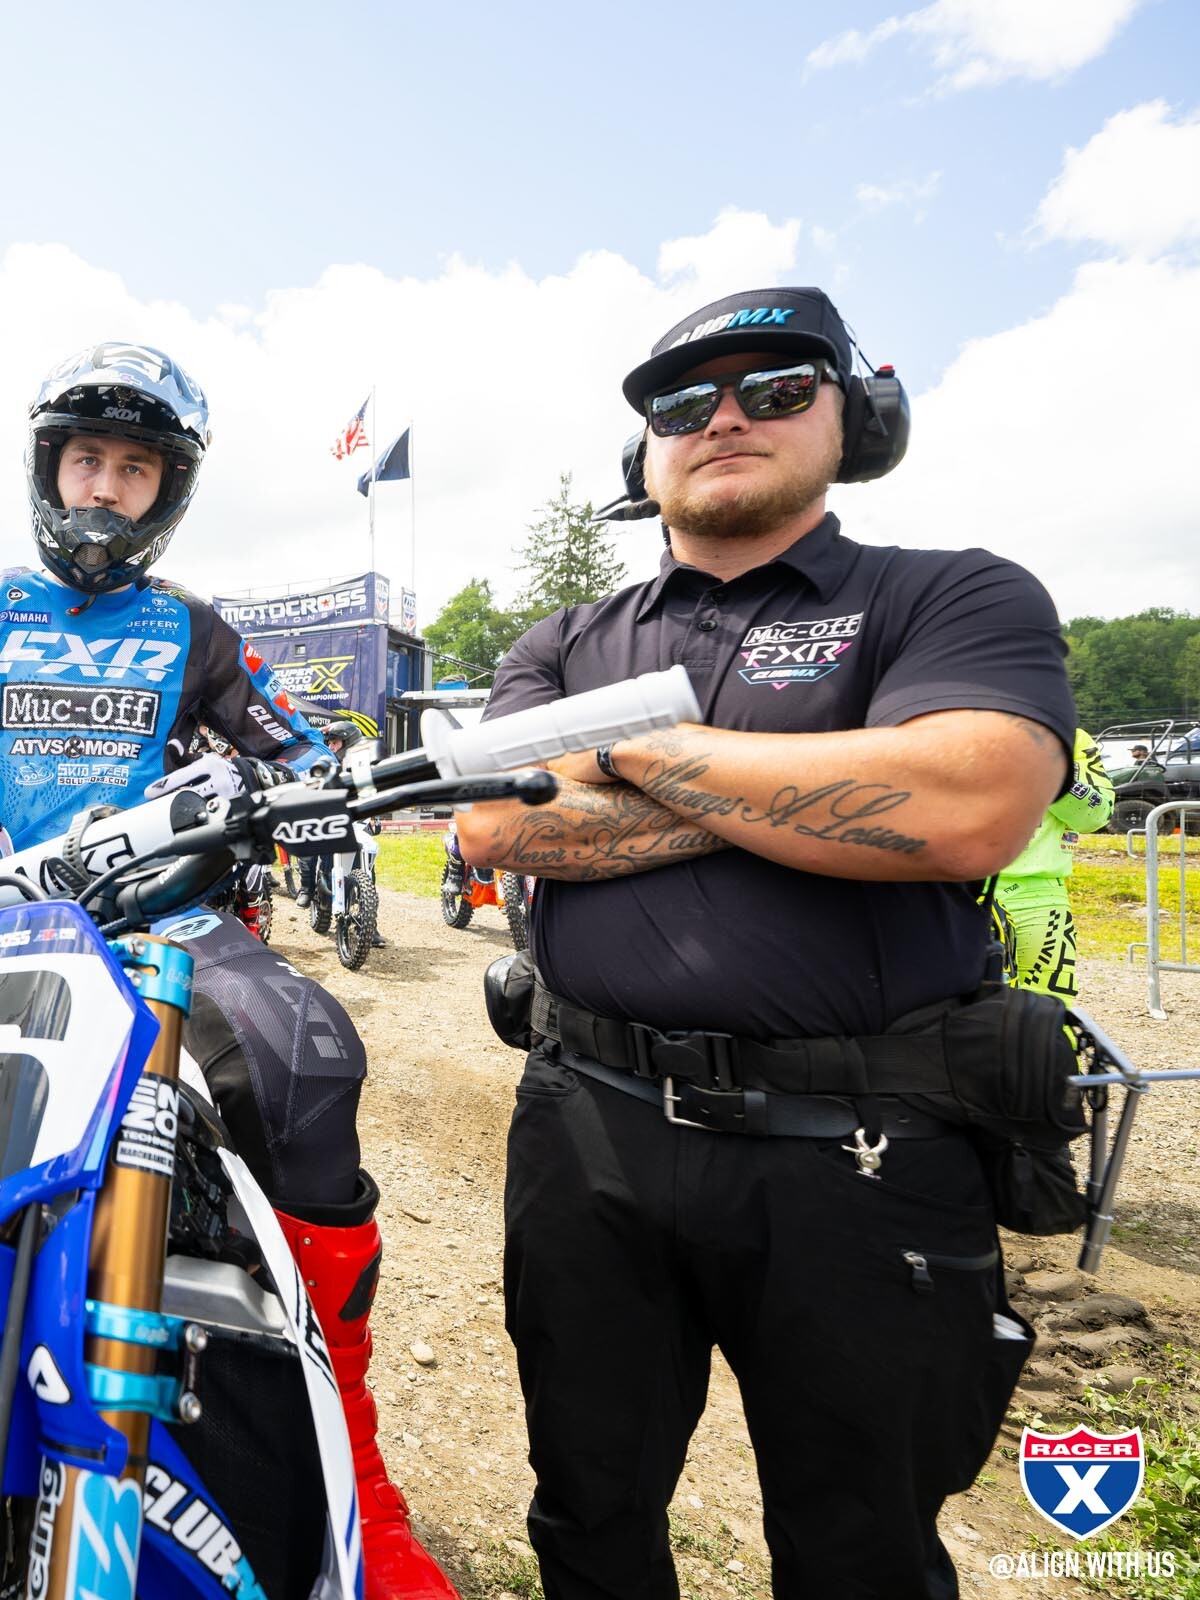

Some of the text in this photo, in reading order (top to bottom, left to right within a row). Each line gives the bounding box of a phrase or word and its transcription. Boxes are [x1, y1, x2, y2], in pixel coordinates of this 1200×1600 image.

[101, 406, 142, 423] SKDA
[220, 587, 368, 622] MOTOCROSS
[7, 612, 48, 623] YAMAHA
[127, 619, 180, 629] JEFFERY
[231, 605, 368, 630] HAMPIONSHIP
[747, 618, 858, 643] Muc-Off
[745, 641, 842, 666] FXR
[8, 692, 153, 729] Muc-Off
[247, 704, 298, 746] CLUB
[10, 736, 142, 760] ATVS&MORE
[272, 814, 350, 844] ARC
[144, 1464, 268, 1599] CLUB
